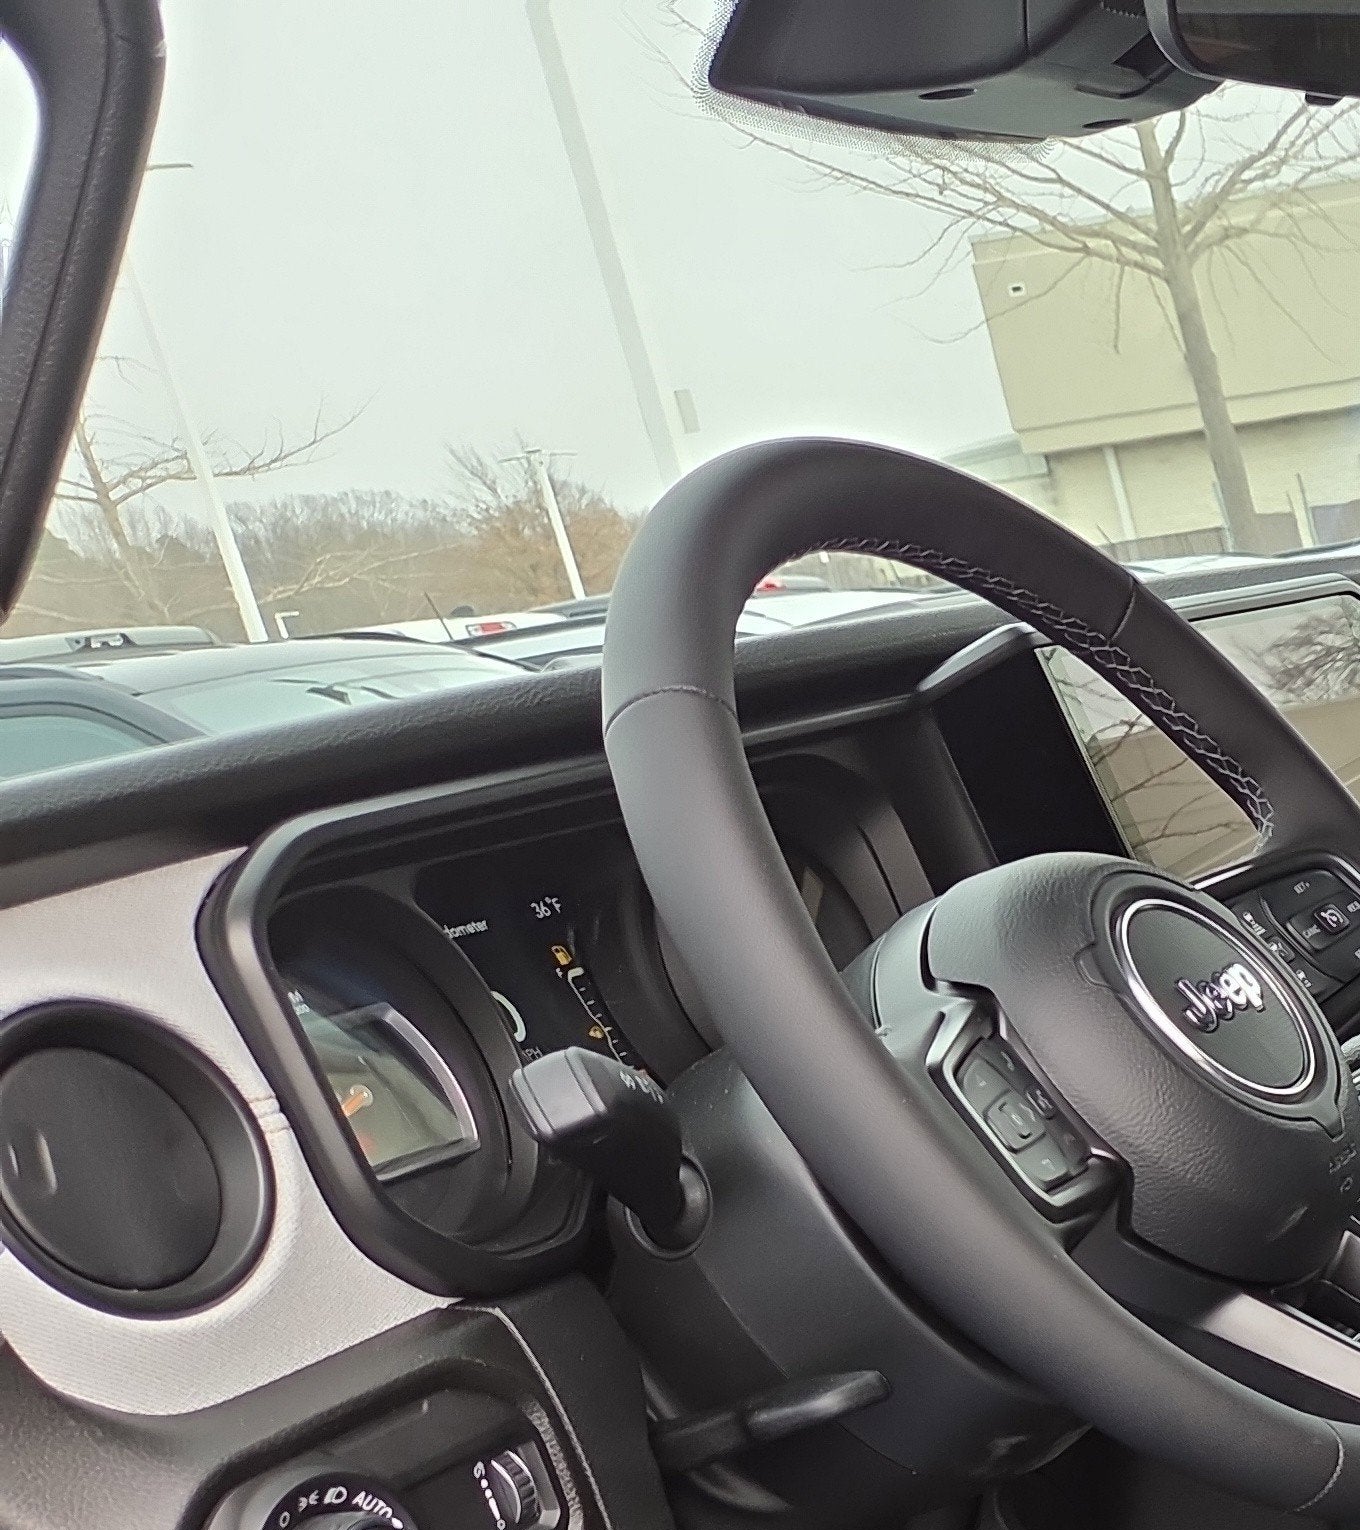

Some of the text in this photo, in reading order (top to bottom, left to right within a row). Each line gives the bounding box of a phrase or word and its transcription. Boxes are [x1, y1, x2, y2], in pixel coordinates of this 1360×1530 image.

[530, 896, 562, 920] 36°F
[1176, 963, 1264, 1032] Jeep
[352, 1490, 393, 1518] AUTO
